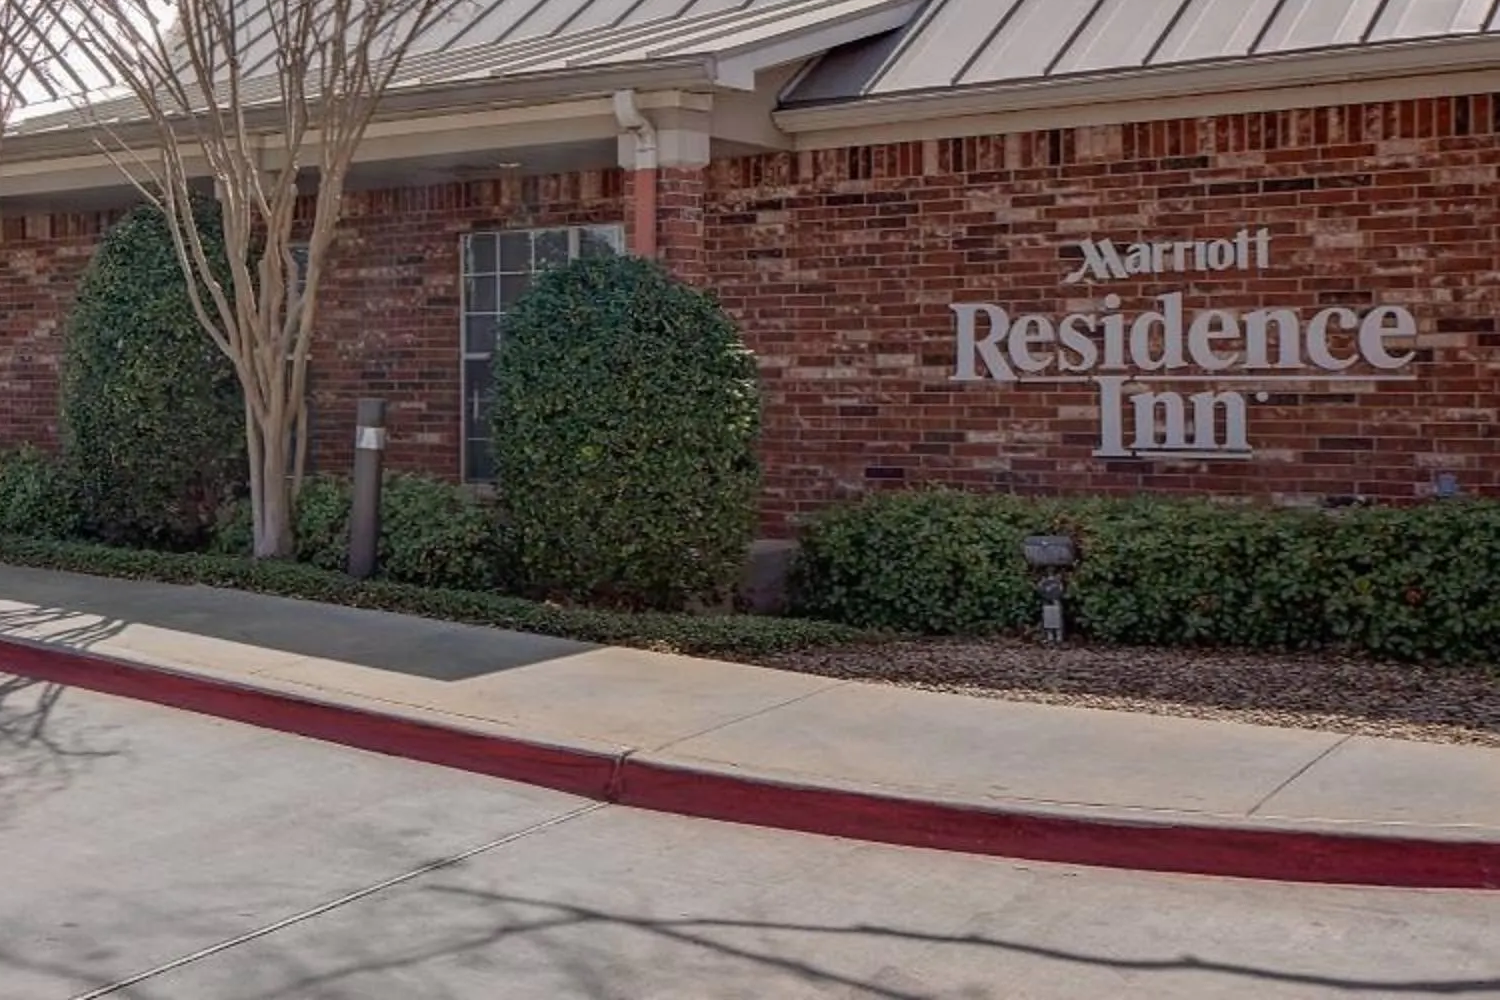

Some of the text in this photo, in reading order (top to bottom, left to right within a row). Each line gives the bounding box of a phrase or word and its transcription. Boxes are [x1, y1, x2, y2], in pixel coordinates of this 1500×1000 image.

[1062, 227, 1271, 283] Marriott
[948, 292, 1417, 382] Residence
[1092, 376, 1252, 459] Inn
